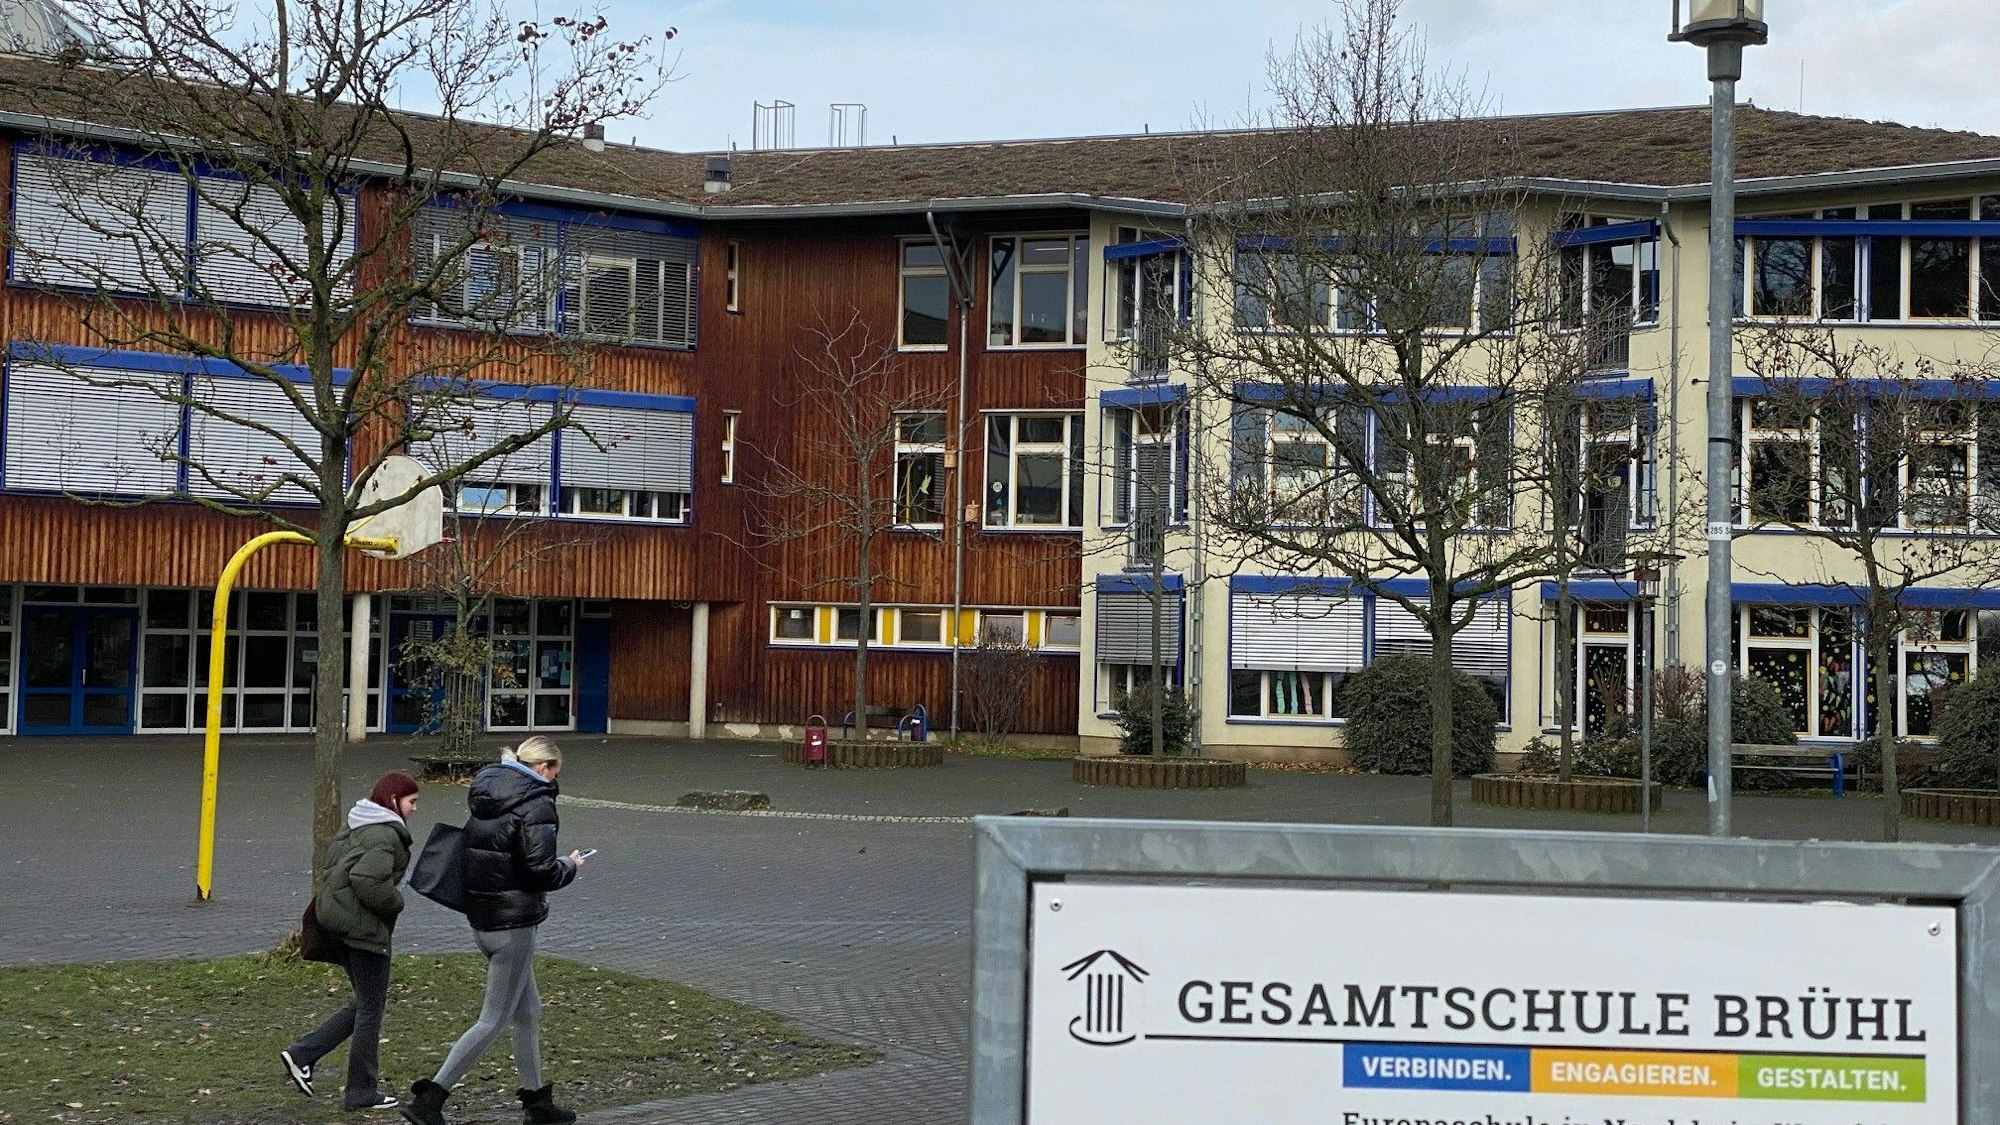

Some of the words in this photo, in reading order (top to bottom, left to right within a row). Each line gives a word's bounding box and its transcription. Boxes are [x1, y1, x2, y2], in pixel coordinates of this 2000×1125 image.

[1710, 526, 1723, 535] 285
[1178, 980, 1690, 1036] GESAMTSCHULE
[1714, 987, 1926, 1042] BRÜHL
[1361, 1056, 1512, 1081] VERBINDEN.
[1551, 1061, 1718, 1087] ENGAGIEREN.
[1757, 1066, 1907, 1092] GESTALTEN.
